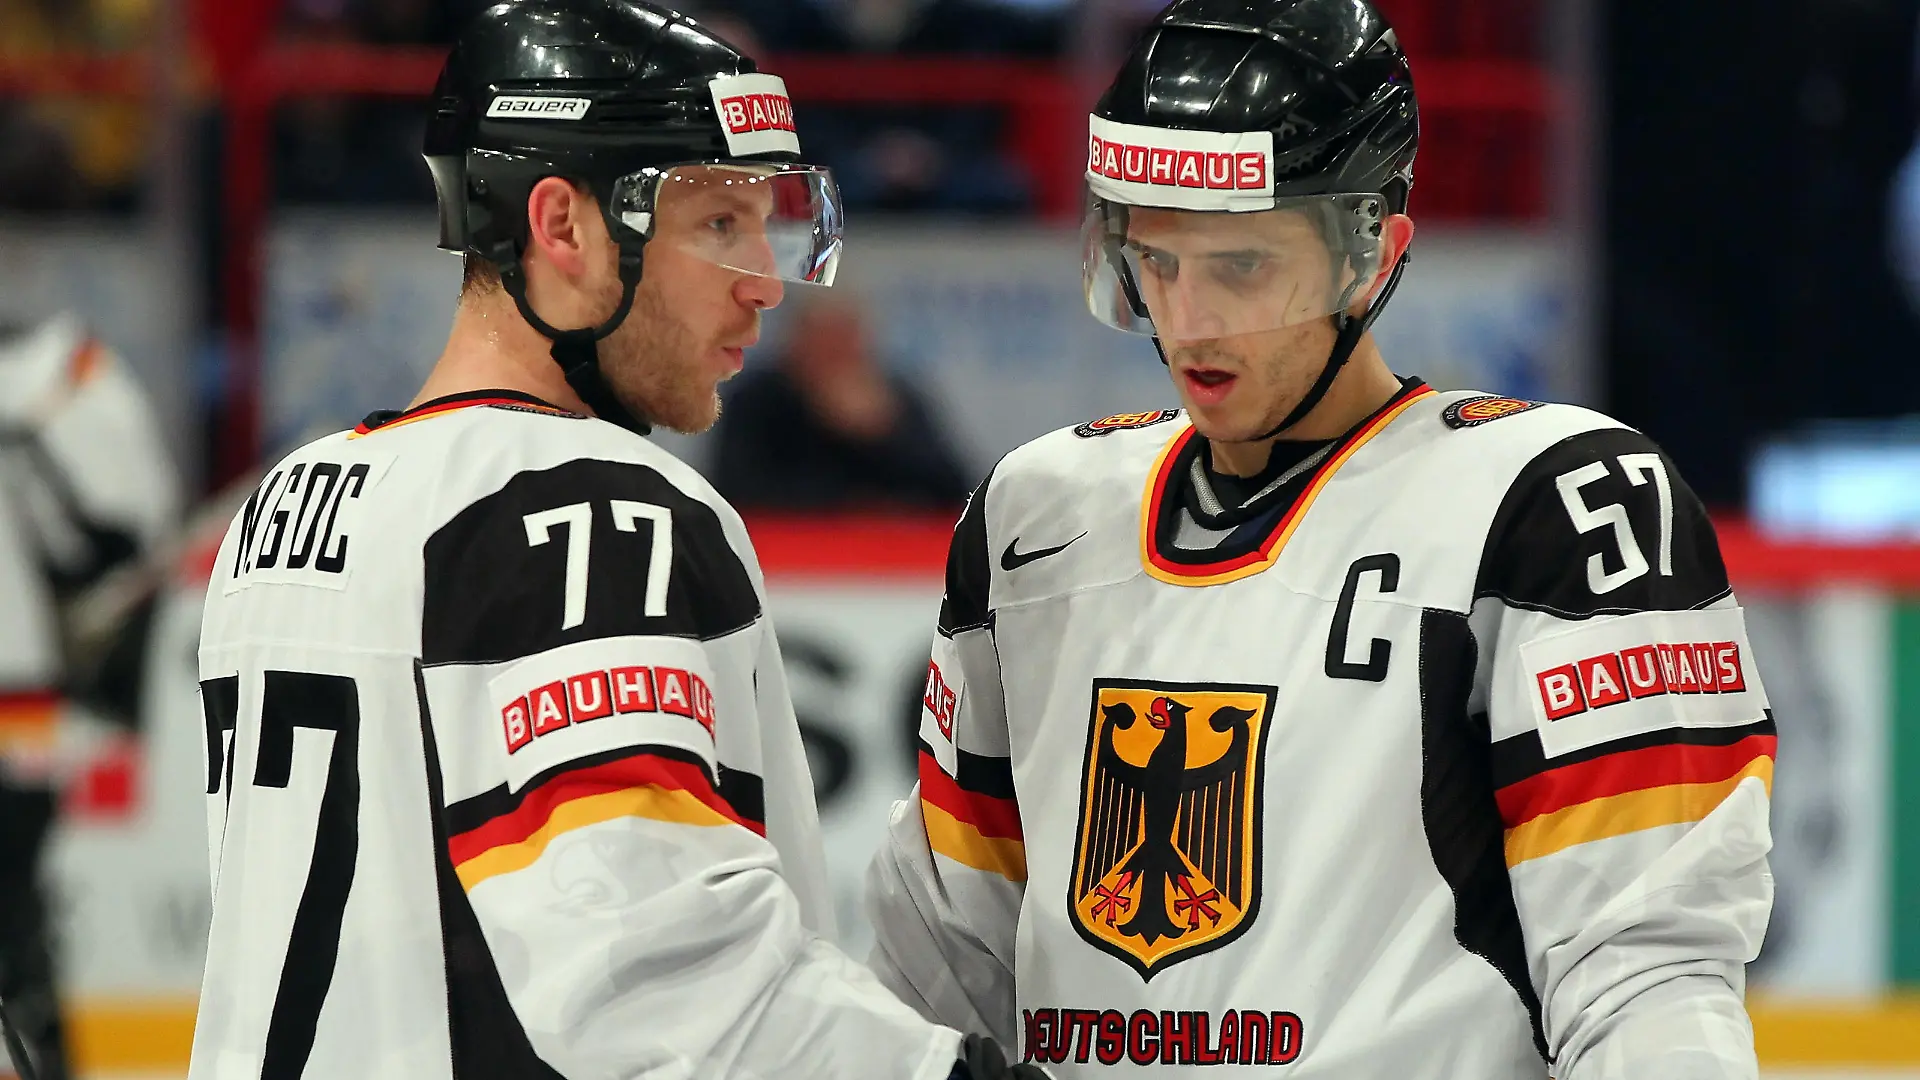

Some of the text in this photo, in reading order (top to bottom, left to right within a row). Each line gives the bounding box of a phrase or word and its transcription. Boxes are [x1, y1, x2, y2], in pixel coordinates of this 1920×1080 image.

[497, 100, 577, 112] BAUER
[1091, 138, 1262, 184] BAUHAUS
[522, 499, 673, 630] 77
[1555, 453, 1674, 595] 57
[1324, 553, 1400, 682] C
[1543, 646, 1740, 712] BAUHAUS
